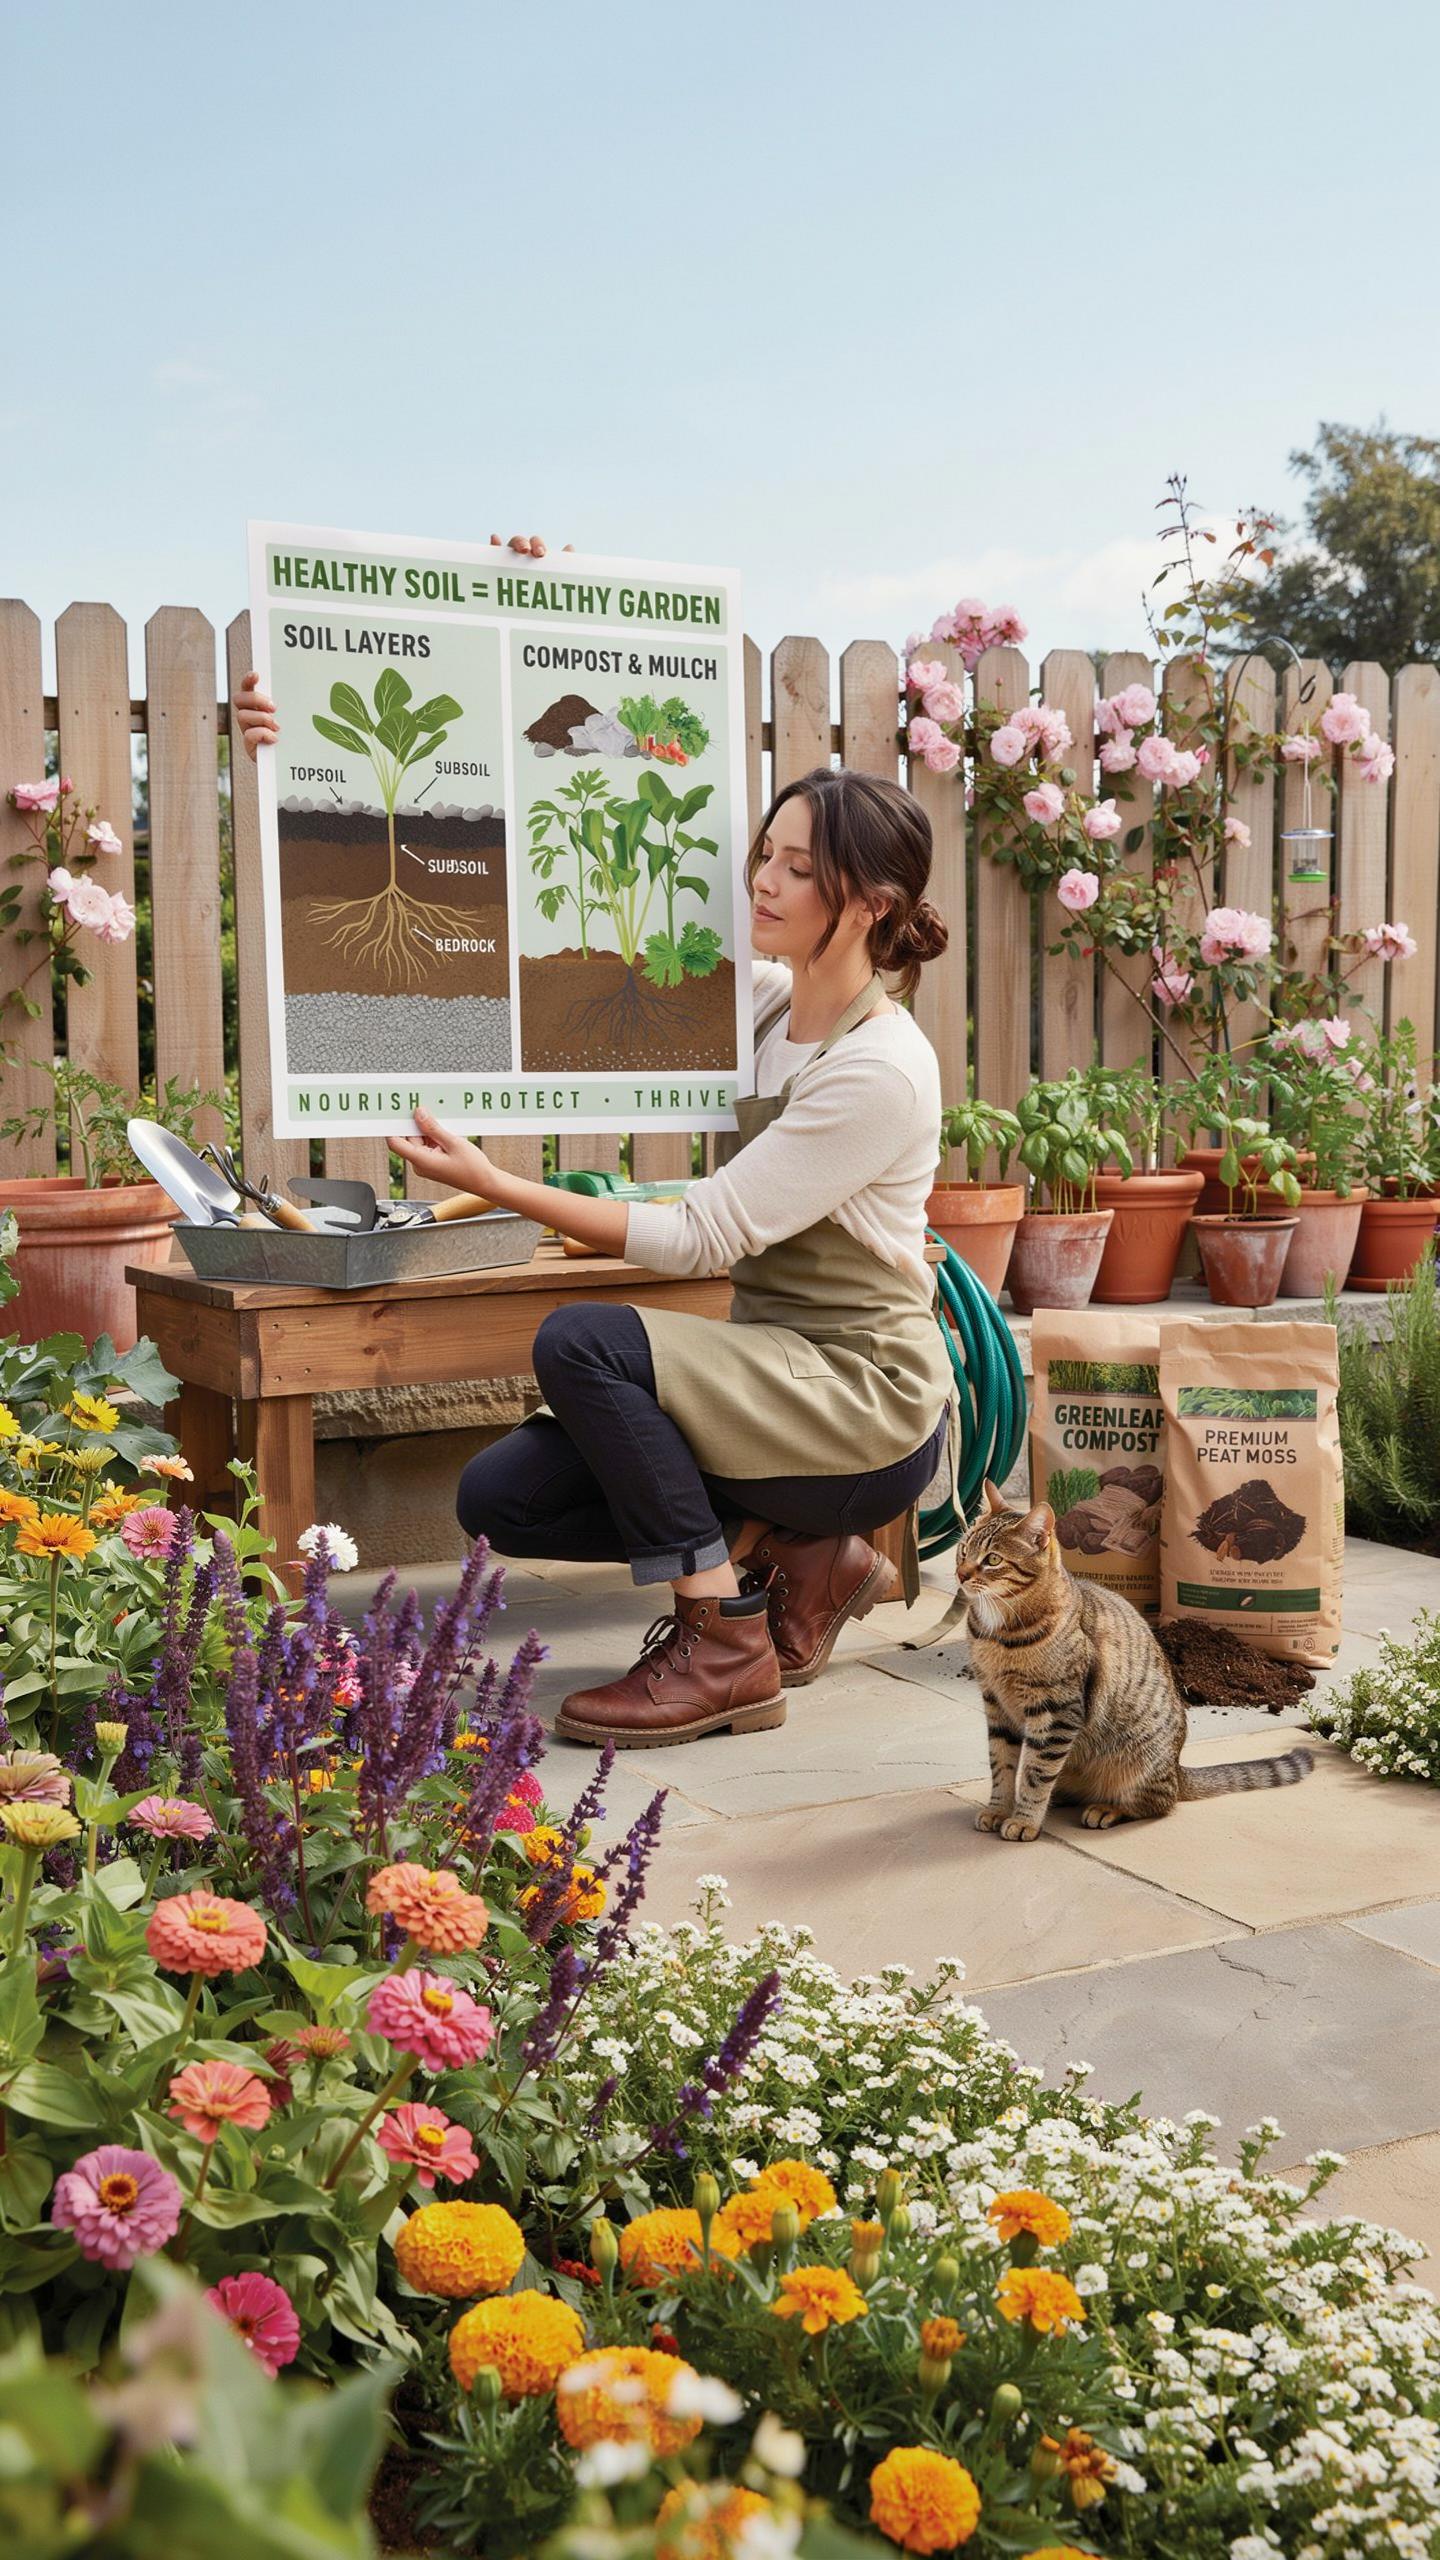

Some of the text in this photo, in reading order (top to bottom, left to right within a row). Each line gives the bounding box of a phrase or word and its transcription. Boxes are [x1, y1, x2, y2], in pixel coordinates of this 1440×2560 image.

[273, 555, 721, 625] HEALTHY SOIL = HEALTHY GARDEN
[283, 623, 431, 658] SOIL LAYERS
[522, 645, 718, 681] COMPOST & MULCH
[290, 766, 347, 783] TOPSOIL
[435, 760, 491, 777] SUBSOIL
[435, 938, 496, 953] BEDROCK
[299, 1092, 420, 1112] NOURISH
[464, 1091, 581, 1111] PROTECT
[634, 1089, 728, 1108] THRIVE
[1055, 1404, 1164, 1429] GREENLEAF
[1063, 1428, 1159, 1453] COMPOST
[1205, 1429, 1288, 1446] PREMIUM
[1197, 1447, 1297, 1465] PEAT MOSS
